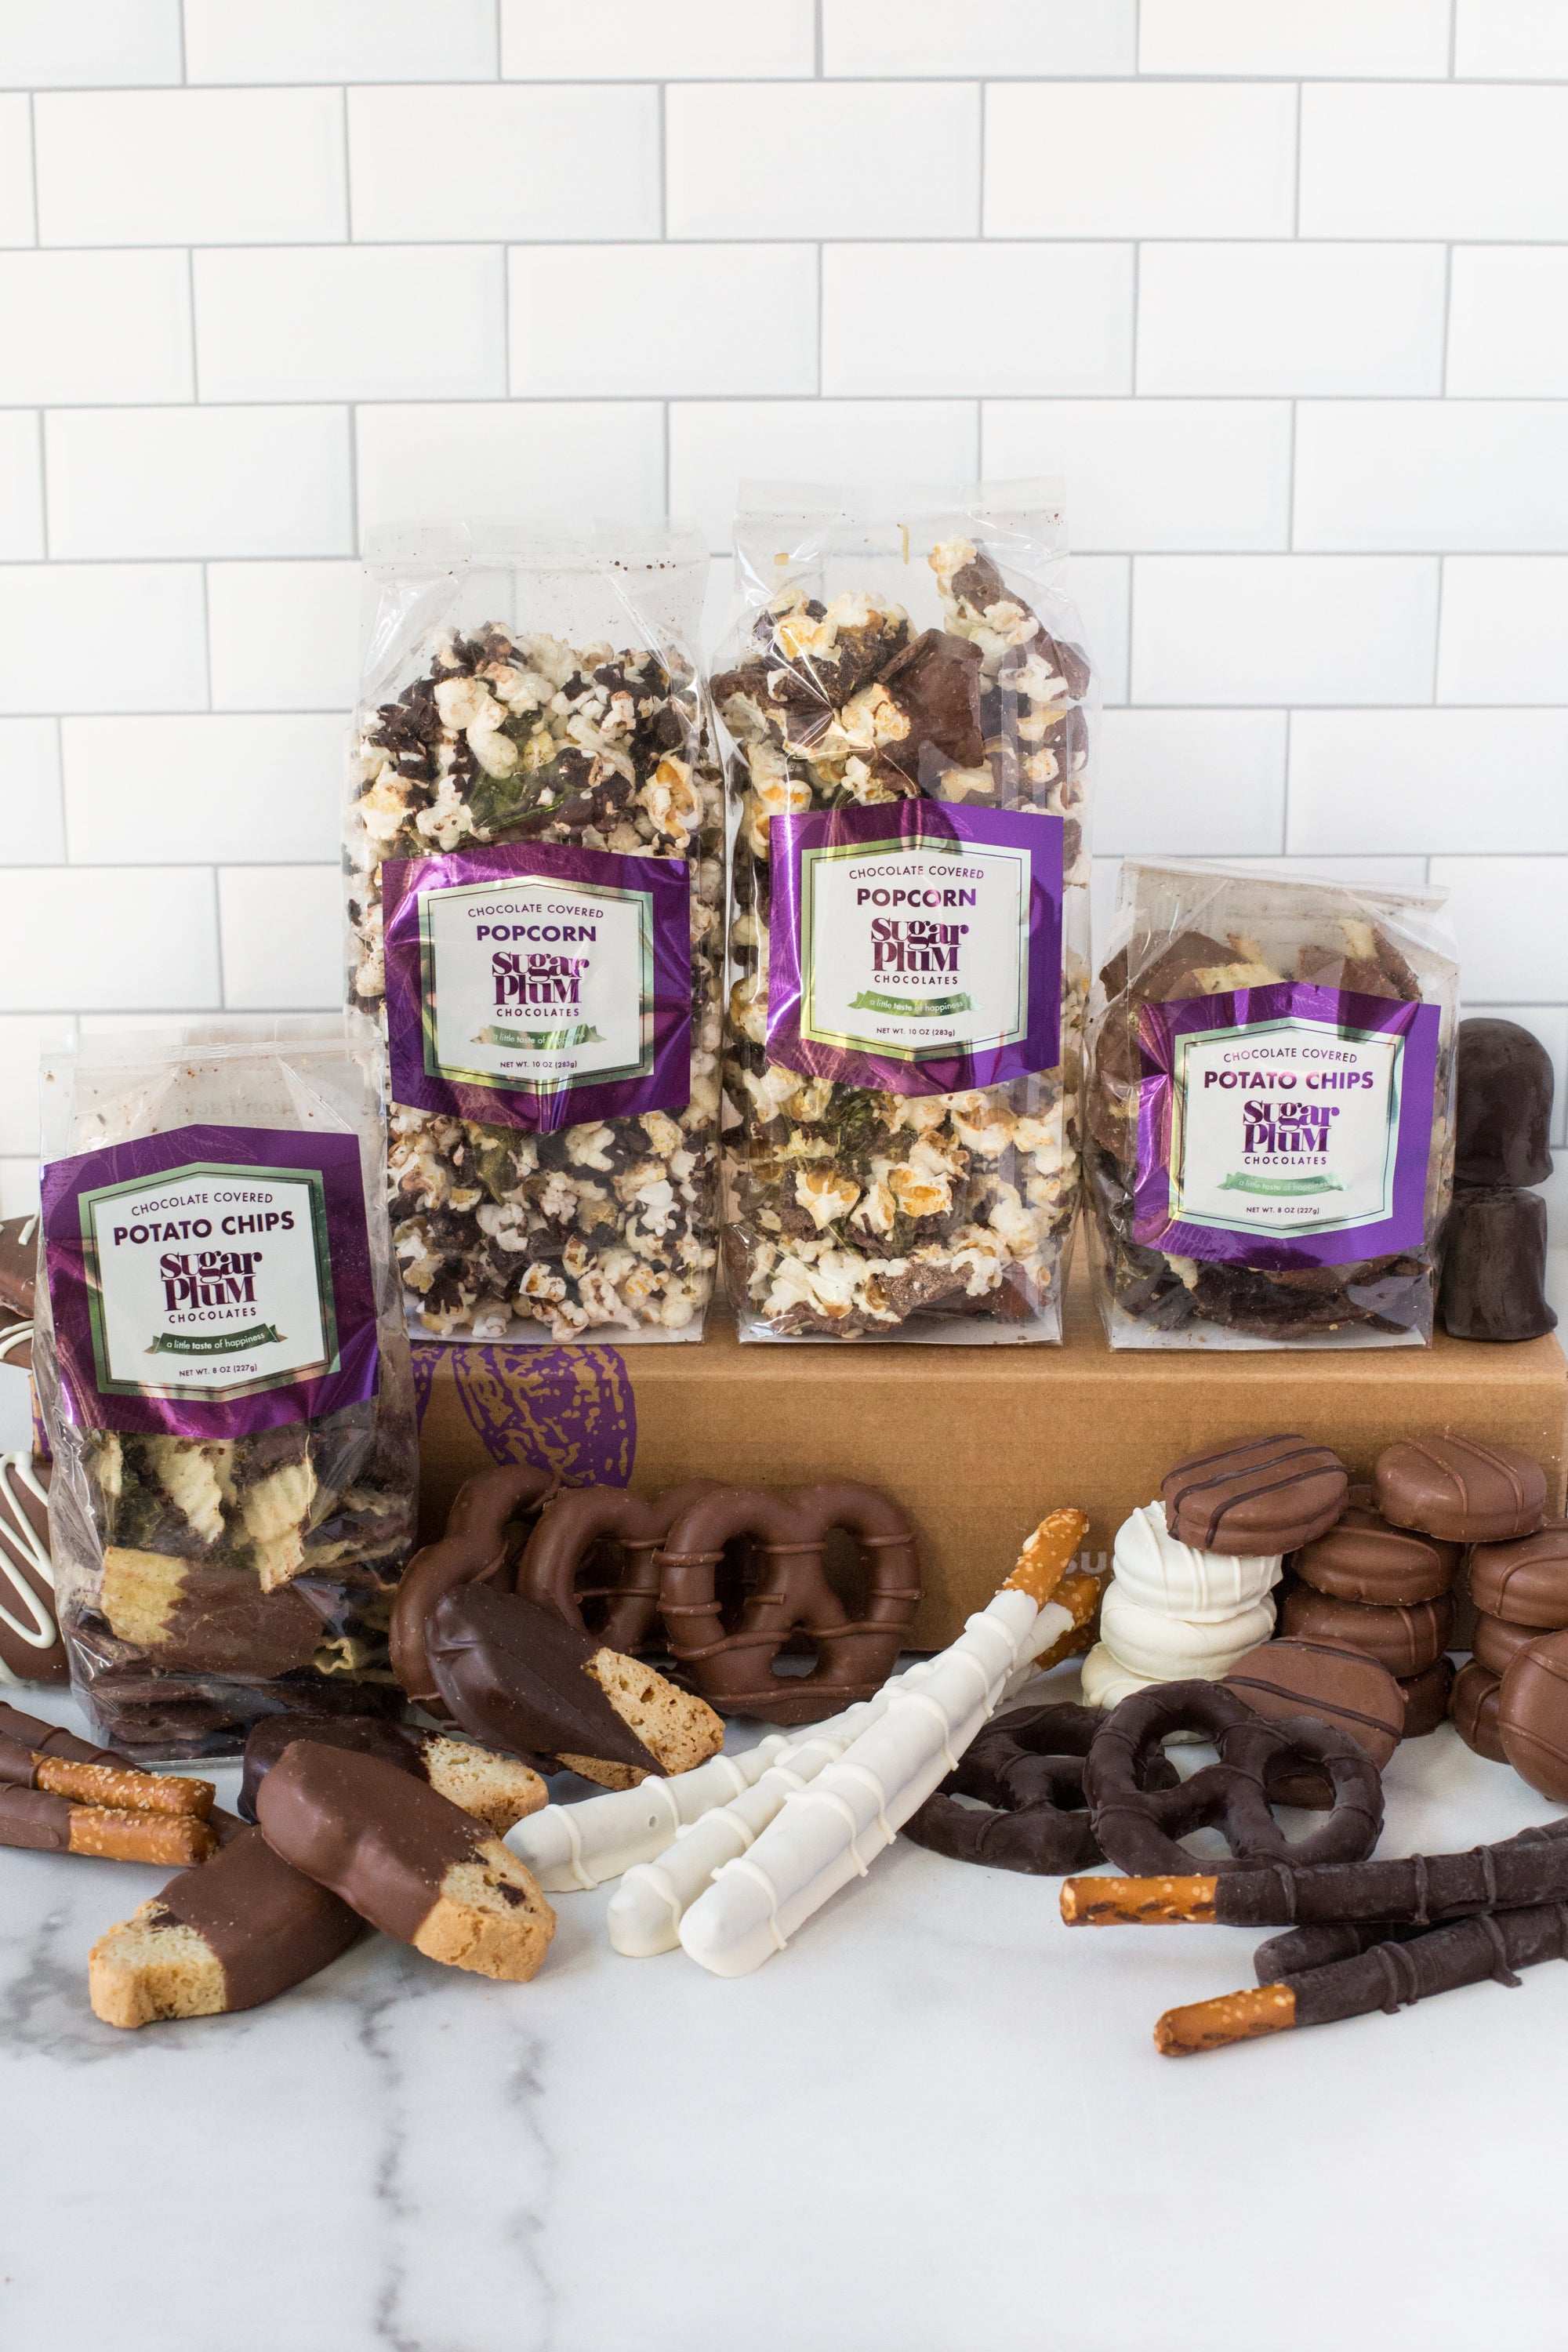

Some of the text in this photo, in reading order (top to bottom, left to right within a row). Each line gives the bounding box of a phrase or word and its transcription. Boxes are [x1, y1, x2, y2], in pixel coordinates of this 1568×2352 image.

[849, 866, 984, 880] CHOCOLATE COVERED
[857, 888, 976, 907] POPCORN
[468, 904, 604, 918] CHOCOLATE COVERED
[477, 925, 597, 942] POPCORN
[874, 975, 958, 985] CHOCOLATES
[496, 1008, 579, 1017] CHOCOLATES
[893, 1003, 913, 1011] taste
[517, 1036, 535, 1044] taste
[932, 1029, 955, 1037] (283g)
[1224, 1048, 1357, 1063] CHOCOLATE COVERED
[1204, 1071, 1374, 1089] POTATO CHIPS
[1244, 1156, 1327, 1165] CHOCOLATES
[131, 1192, 273, 1216] CHOCOLATE COVERED
[114, 1210, 295, 1246] POTATO CHIPS
[169, 1307, 256, 1323] CHOCOLATES
[174, 1339, 191, 1349] little
[214, 1339, 223, 1348] of
[225, 1333, 265, 1348] happiness
[234, 1363, 257, 1374] (227g)
